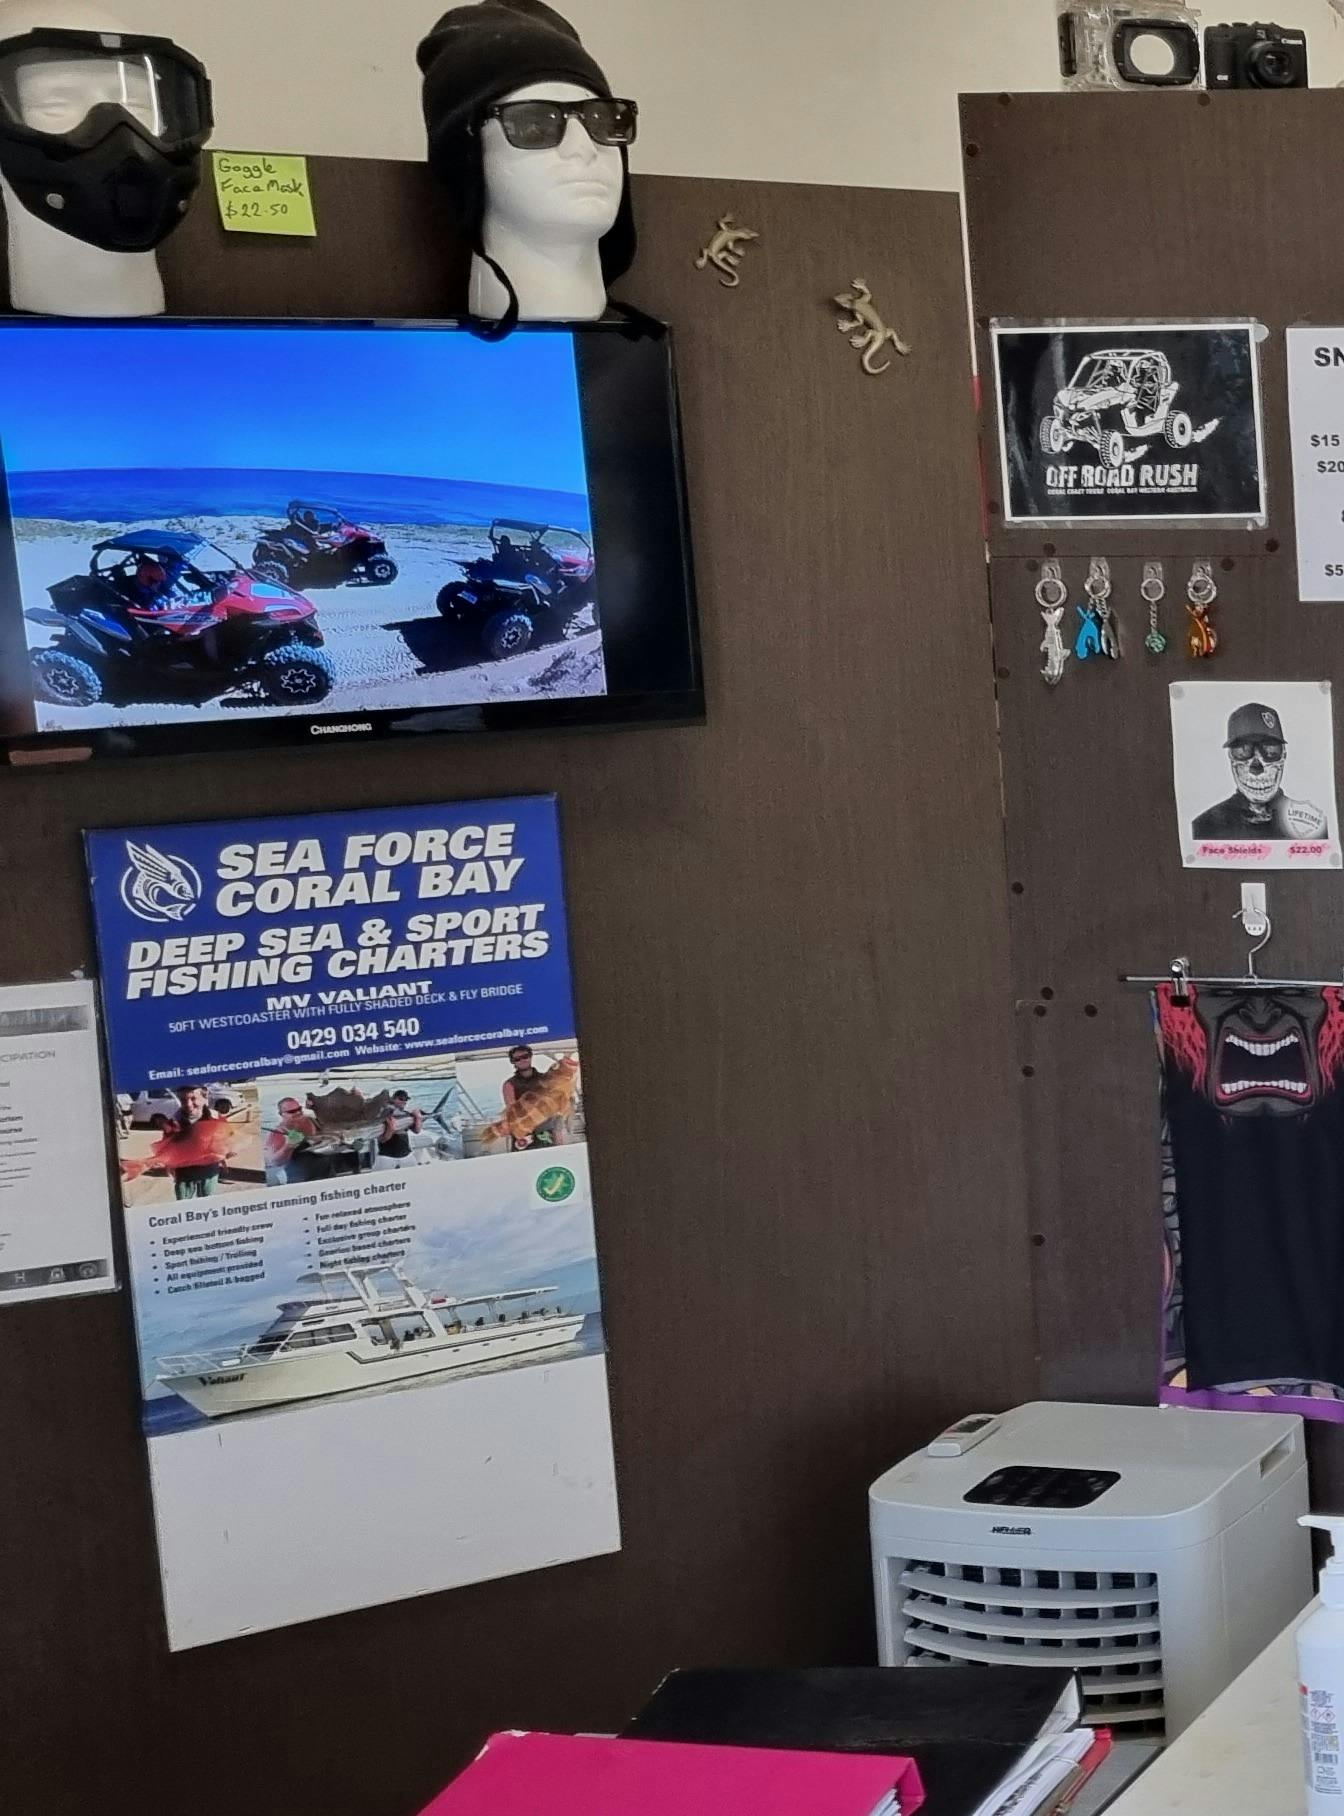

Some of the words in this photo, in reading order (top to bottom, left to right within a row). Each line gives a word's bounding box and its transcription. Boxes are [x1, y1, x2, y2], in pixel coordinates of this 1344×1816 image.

[219, 158, 276, 179] Goggle
[220, 178, 264, 194] Face
[225, 201, 288, 219] $22.50
[1310, 434, 1340, 447] $15
[1046, 465, 1078, 488] OFF
[1081, 464, 1135, 488] ROAD
[1139, 463, 1199, 487] RUSH
[1288, 809, 1322, 826] LIFETIME
[216, 839, 326, 880] SEA
[344, 823, 516, 869] FORCE
[1202, 846, 1225, 854] Face
[1227, 846, 1262, 854] Shields
[1289, 846, 1322, 854] $22.00
[216, 869, 401, 917] CORAL
[418, 858, 525, 899] BAY
[127, 932, 246, 970] DEEP
[257, 923, 344, 957] SEA
[357, 918, 392, 947] &
[405, 903, 545, 942] SPORT
[126, 954, 313, 1000] FISHING
[327, 930, 550, 978] CHARTERS
[168, 1019, 196, 1033] 50FT
[199, 1009, 290, 1029] WESTCOASTER
[292, 1005, 326, 1019] WITH
[328, 1002, 361, 1015] FULLY
[365, 997, 413, 1011] SHADED
[415, 993, 446, 1006] DECK
[449, 992, 458, 1001] &
[460, 989, 479, 1000] FLY
[480, 983, 524, 998] BRIDGE
[266, 993, 312, 1011] MV
[318, 980, 433, 1005] VALIANT
[287, 1026, 337, 1050] 0429
[341, 1022, 379, 1043] 034
[383, 1017, 420, 1038] 540
[148, 1067, 185, 1081] Email:
[186, 1049, 350, 1077] seaforcecoralbay@gmail.com
[354, 1042, 402, 1056] Website:
[404, 1025, 549, 1050] www.seaforcecoralbay.com
[149, 1213, 182, 1228] Coral
[186, 1208, 219, 1222] Bay's
[222, 1202, 268, 1216] longest
[271, 1194, 317, 1209] running
[321, 1188, 360, 1201] fishing
[363, 1182, 406, 1196] charter
